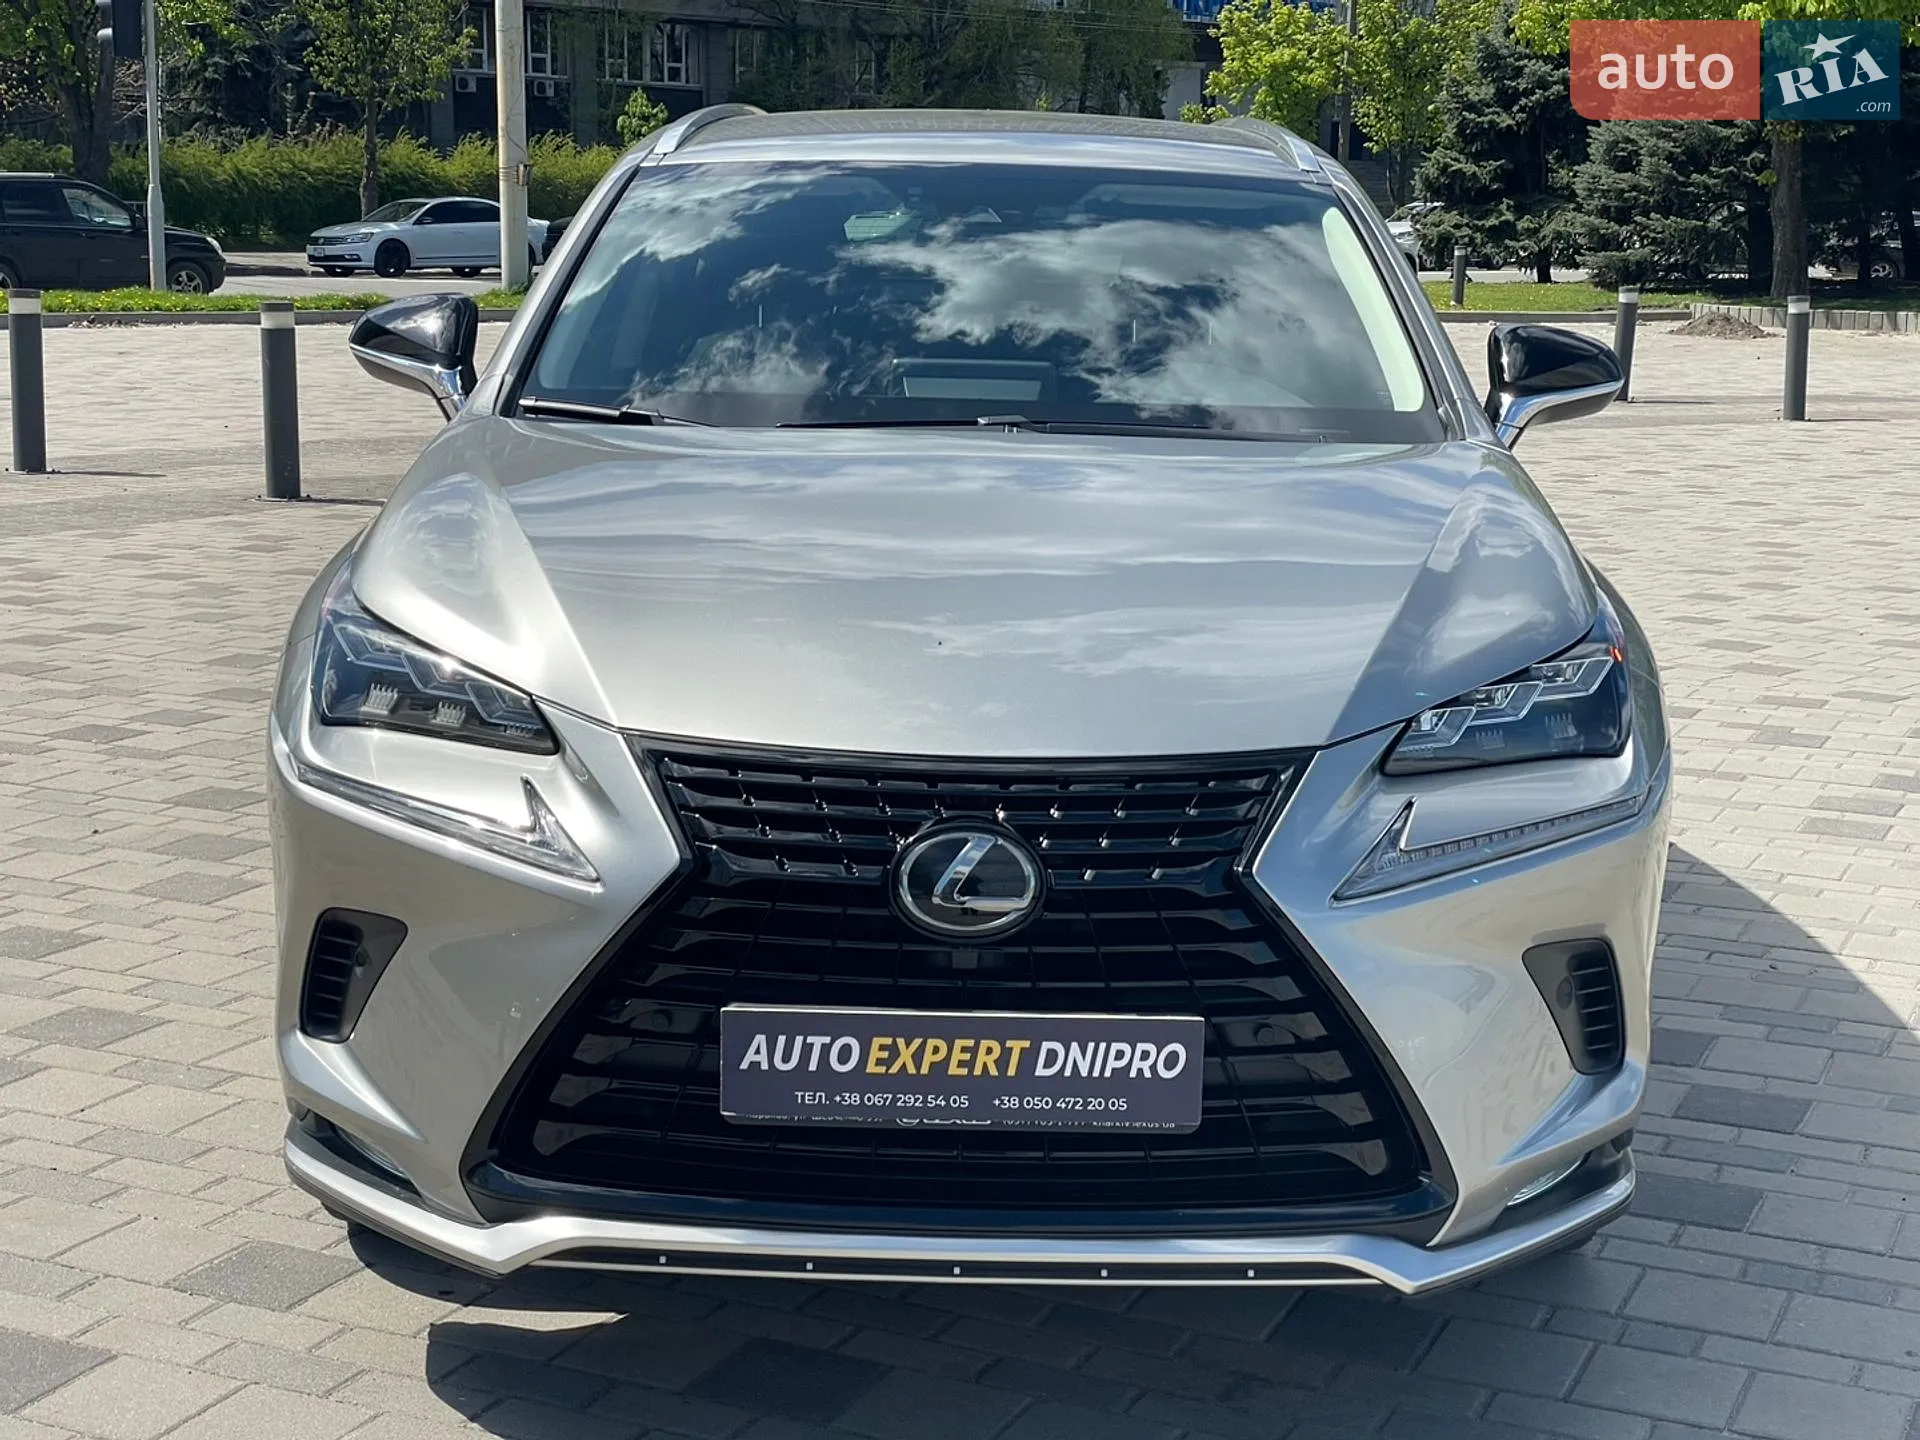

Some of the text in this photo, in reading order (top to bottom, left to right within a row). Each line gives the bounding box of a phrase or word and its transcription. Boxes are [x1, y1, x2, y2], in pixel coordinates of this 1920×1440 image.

[739, 1034, 1187, 1079] AUTO EXPERT DNIPRO
[794, 1091, 1127, 1111] ТЕЛ. +38 067 292 54 05 +38 050 472 20 05
